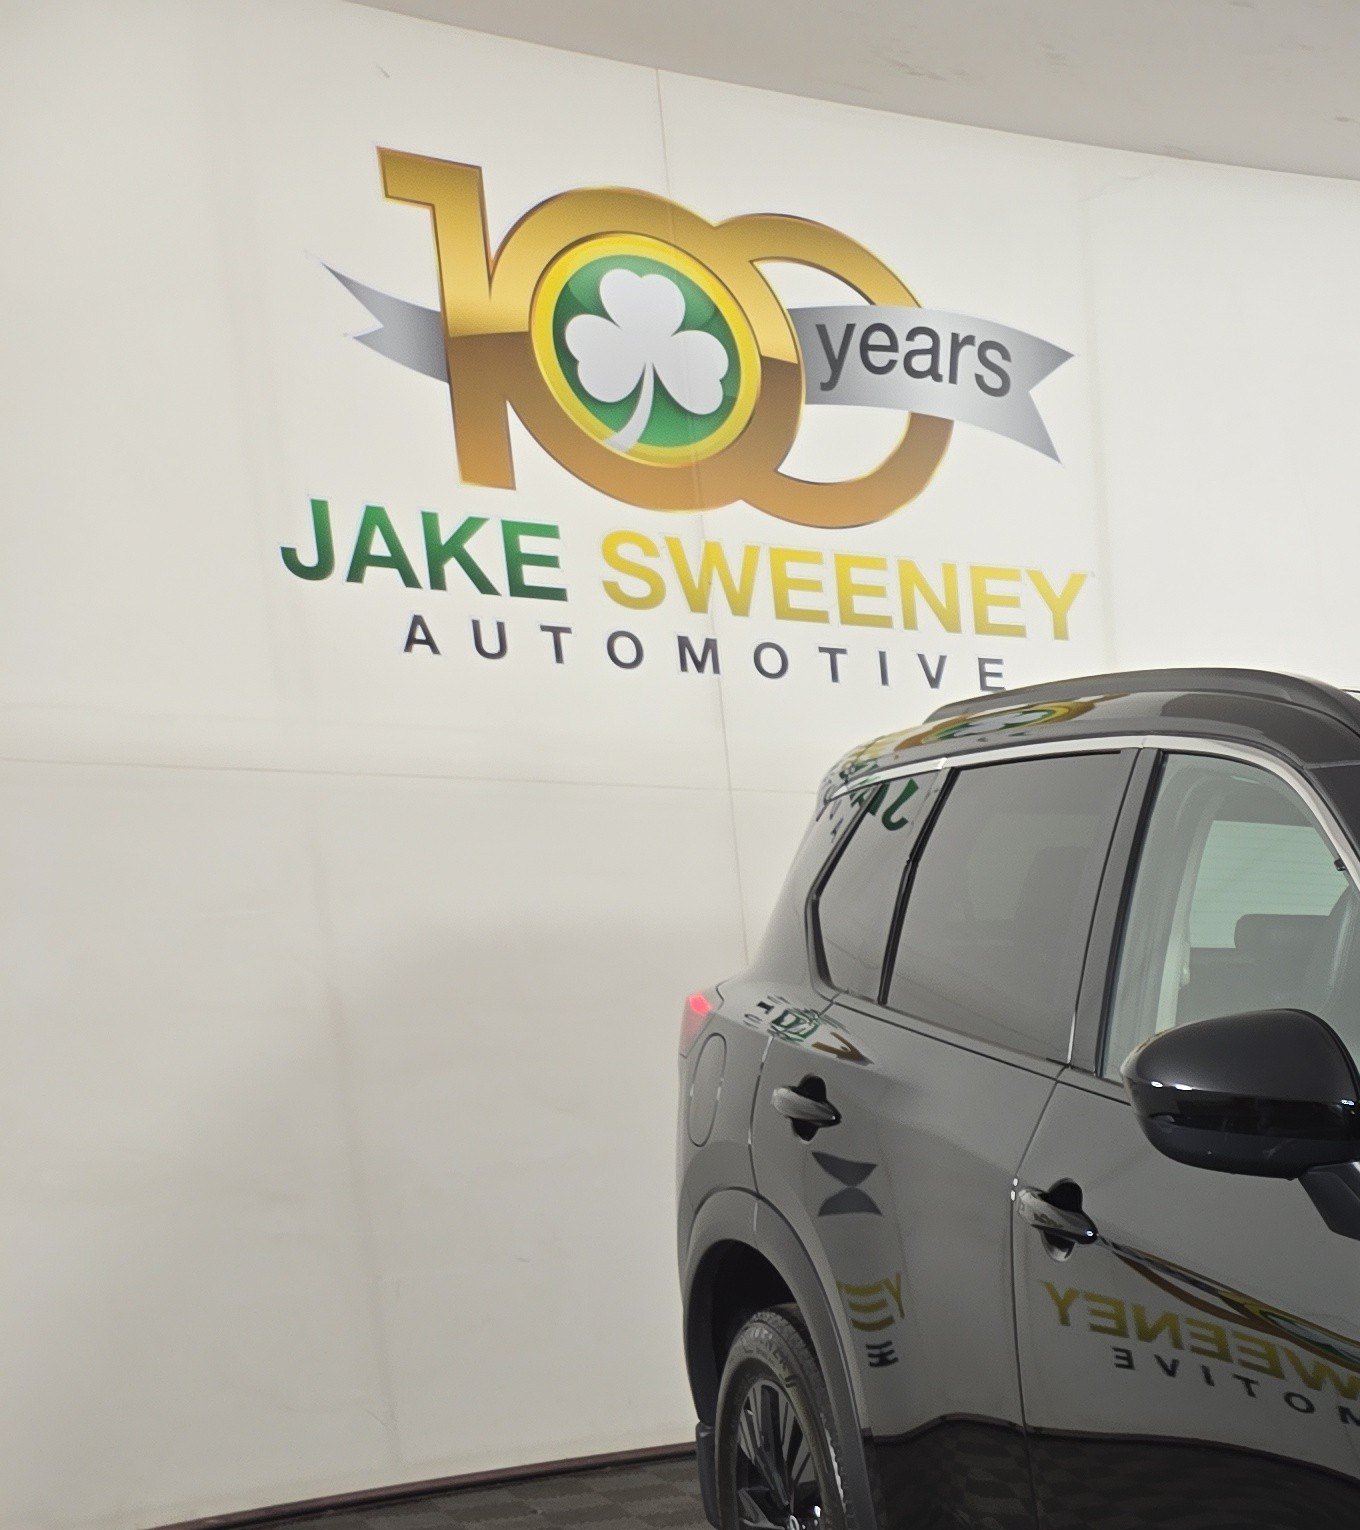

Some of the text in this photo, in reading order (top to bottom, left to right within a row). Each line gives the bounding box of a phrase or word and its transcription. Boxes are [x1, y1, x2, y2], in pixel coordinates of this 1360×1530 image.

[376, 147, 1013, 528] 100 years
[280, 499, 1089, 641] JAKE SWEENEY
[403, 614, 1006, 692] AUTOMOTIVE
